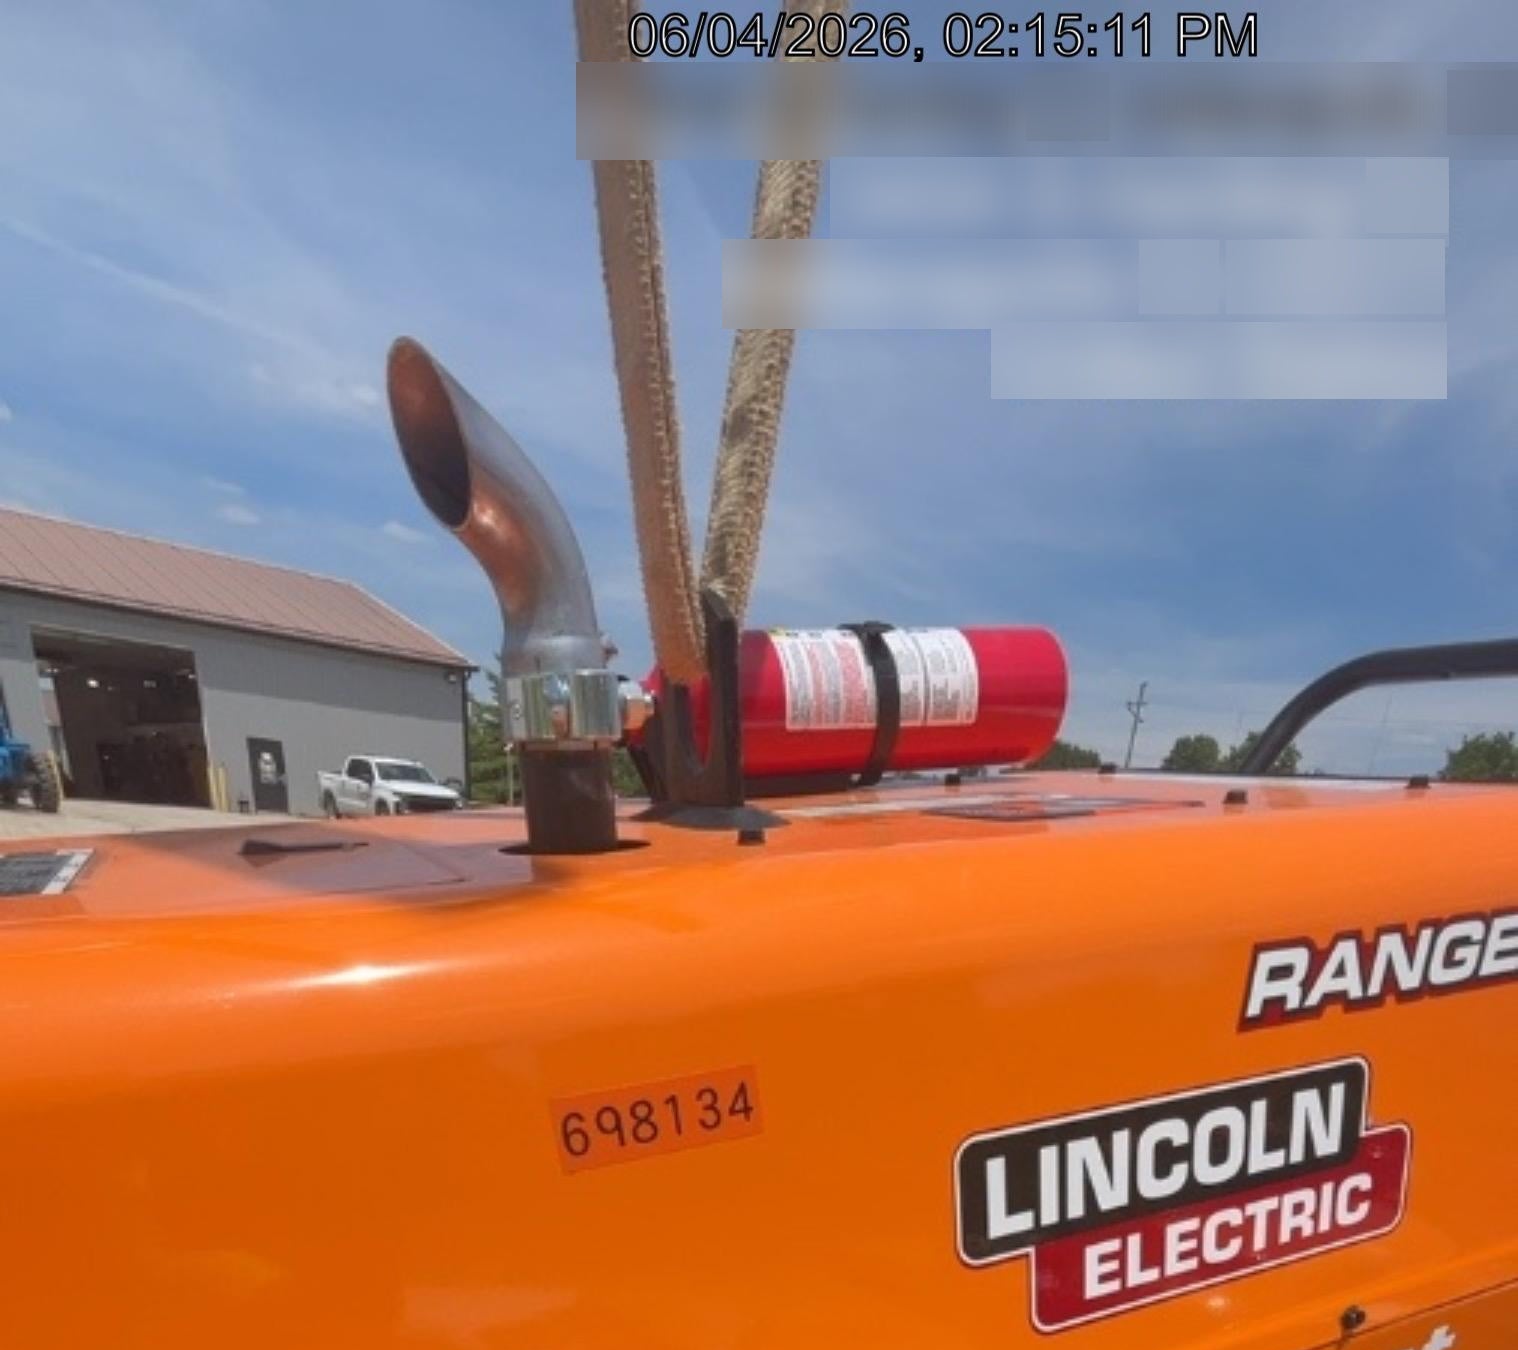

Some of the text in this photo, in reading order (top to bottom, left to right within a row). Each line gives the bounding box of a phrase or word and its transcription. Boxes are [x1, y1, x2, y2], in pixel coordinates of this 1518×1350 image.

[561, 1080, 754, 1156] 698134
[986, 1082, 1346, 1240] LINCOLN
[1083, 1173, 1372, 1301] ELECTRIC
